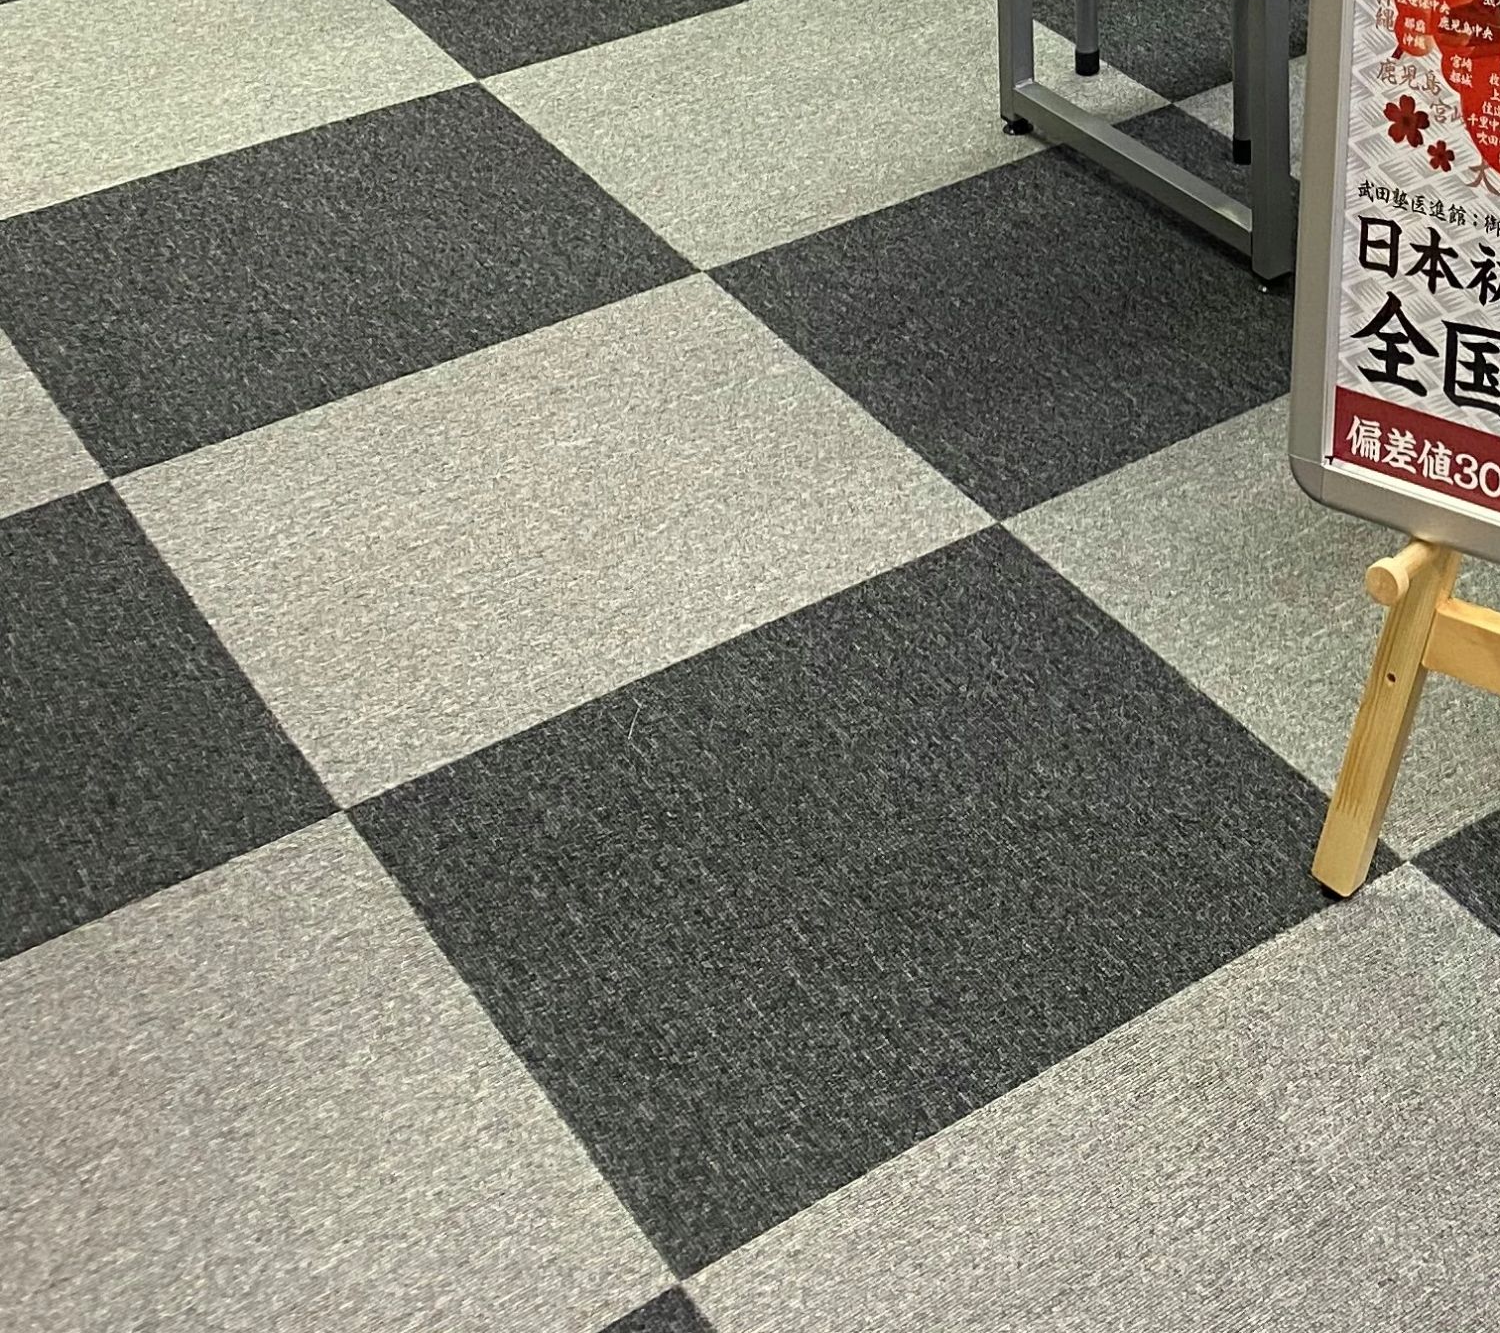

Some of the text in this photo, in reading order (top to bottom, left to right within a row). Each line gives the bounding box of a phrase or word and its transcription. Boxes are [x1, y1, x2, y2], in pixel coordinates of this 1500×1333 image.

[1438, 17, 1494, 40] 鹿児島中央
[1376, 58, 1441, 96] 鹿児島
